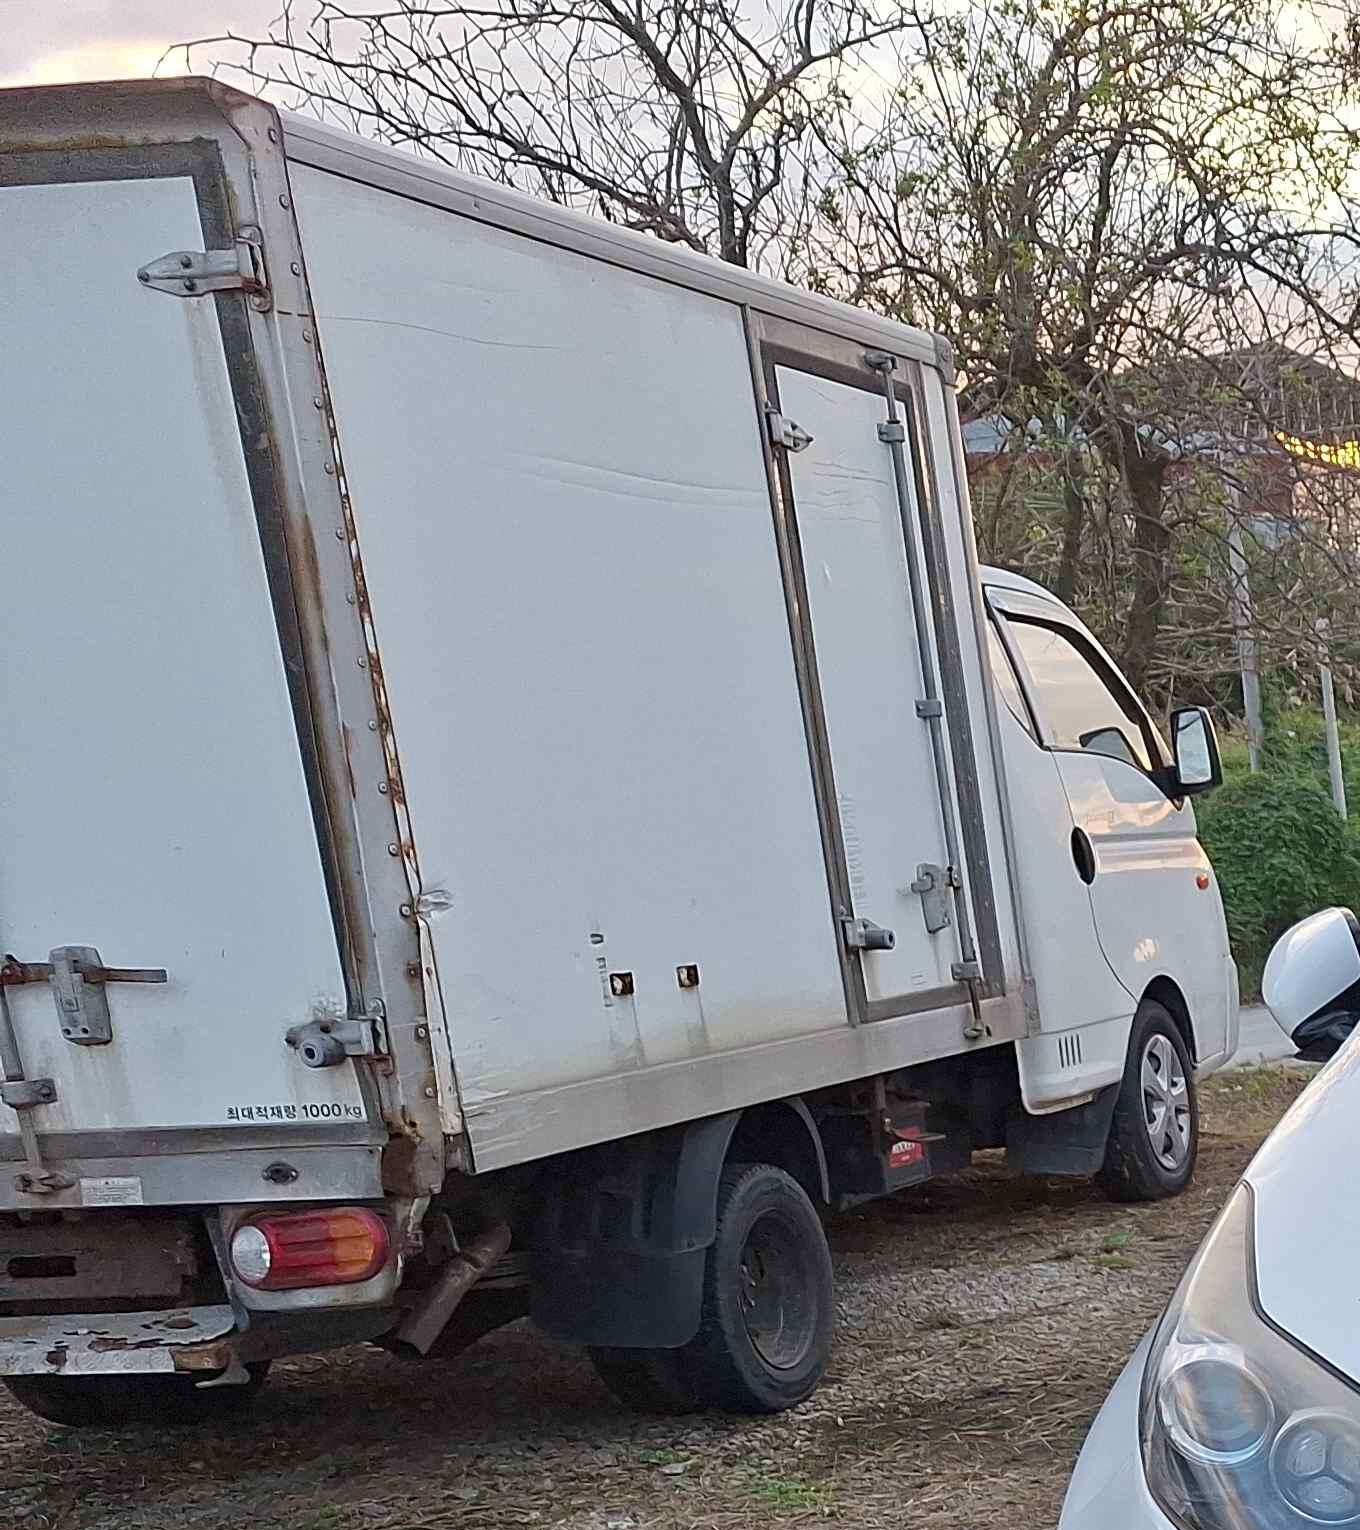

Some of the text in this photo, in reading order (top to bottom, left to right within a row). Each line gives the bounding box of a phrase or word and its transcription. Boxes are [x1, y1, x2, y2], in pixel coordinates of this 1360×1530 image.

[226, 1103, 362, 1121] 최대적재량 1000 kg
